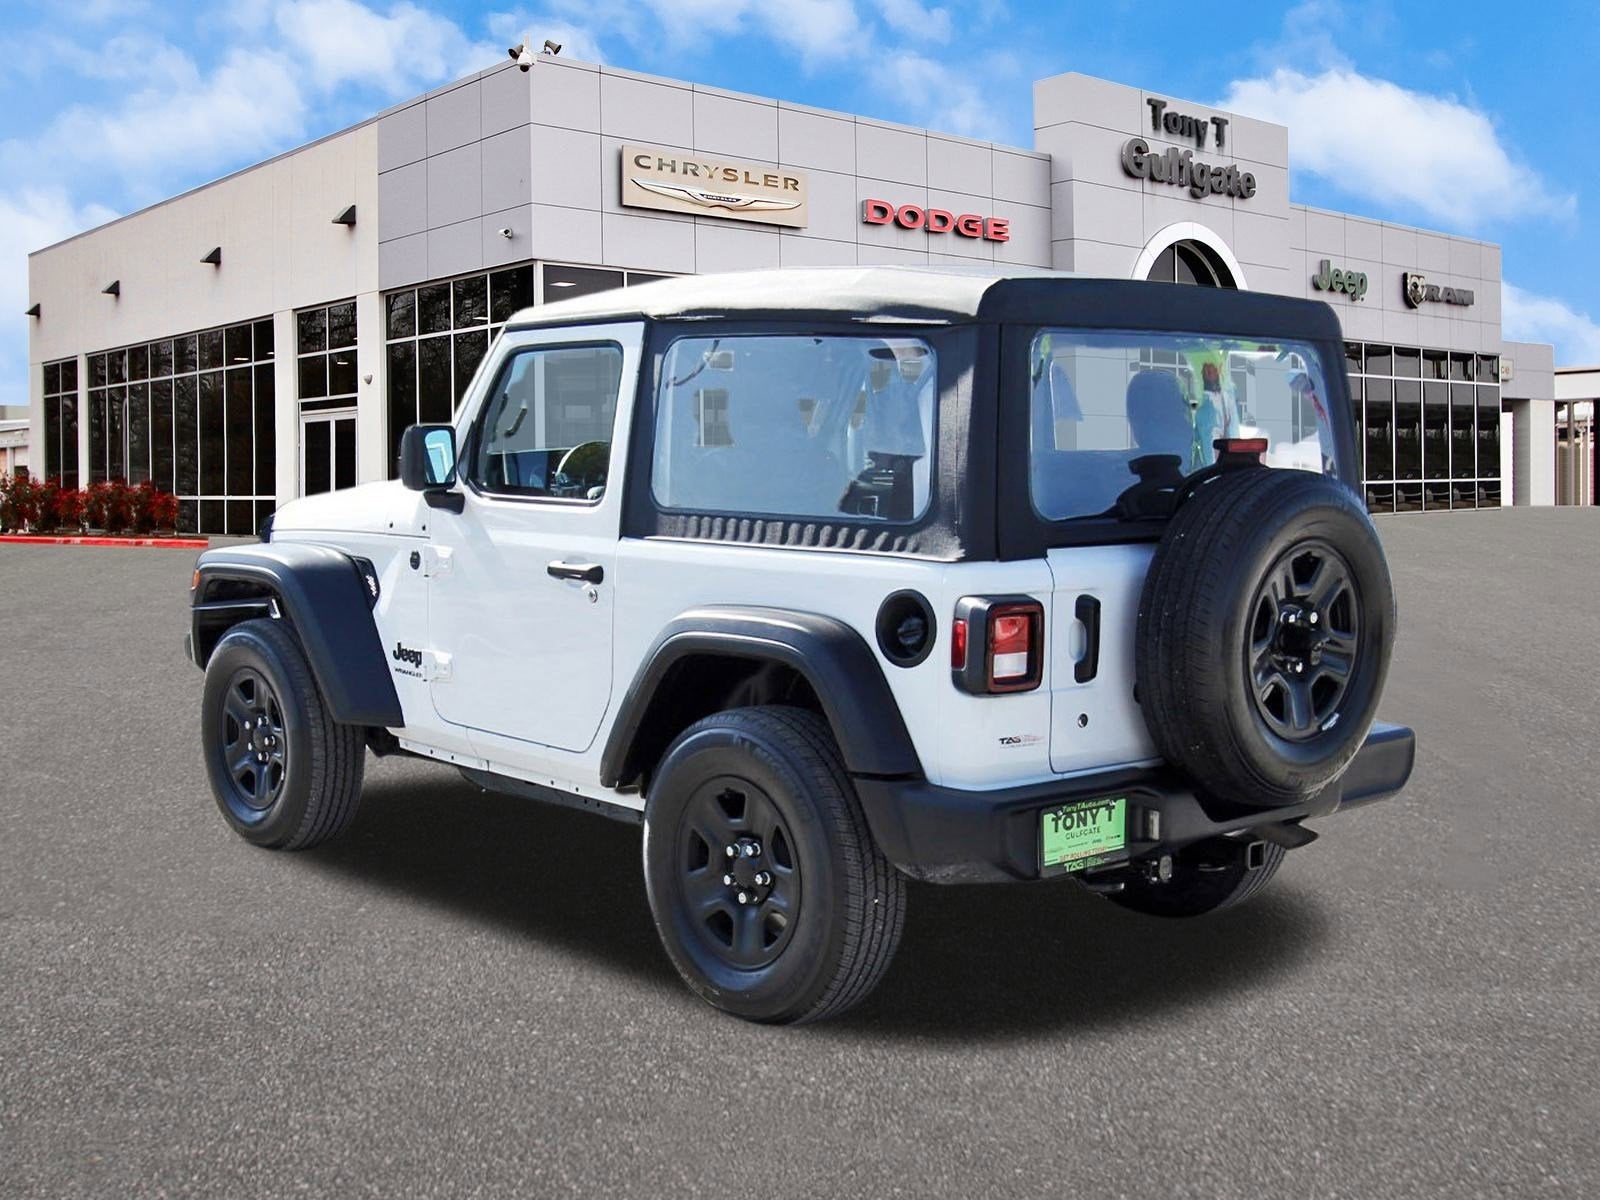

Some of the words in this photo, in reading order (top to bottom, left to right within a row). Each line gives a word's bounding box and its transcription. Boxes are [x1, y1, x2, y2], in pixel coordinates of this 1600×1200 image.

[1146, 98, 1209, 148] Tony
[1210, 115, 1230, 148] T
[634, 154, 801, 191] CHRYSLER
[1121, 137, 1257, 199] Gulfgate
[862, 198, 1010, 242] DODGE
[1312, 259, 1368, 302] Jeep
[1425, 283, 1475, 307] RAM
[393, 641, 423, 668] Jeep
[1051, 807, 1101, 833] TONY
[1104, 803, 1116, 822] T
